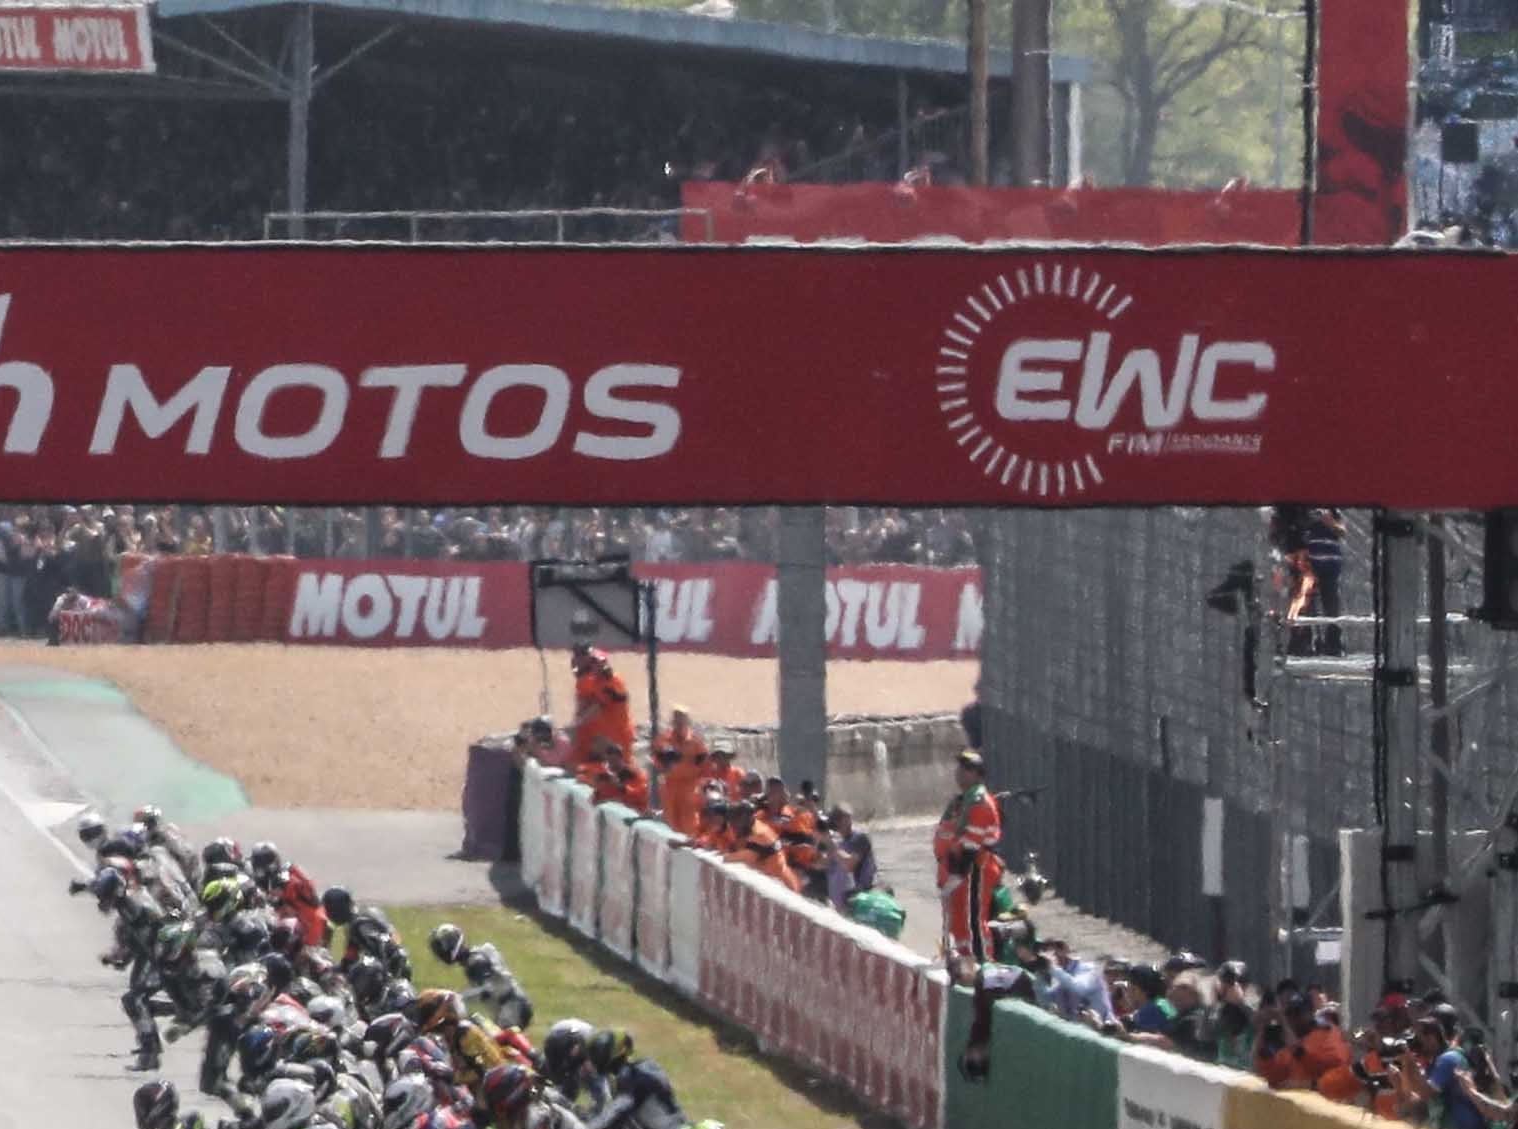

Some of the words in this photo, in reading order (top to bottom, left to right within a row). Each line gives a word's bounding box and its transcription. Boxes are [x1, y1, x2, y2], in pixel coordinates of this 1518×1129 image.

[89, 362, 683, 460] MOTOS
[995, 331, 1277, 431] EWC
[1107, 432, 1164, 454] FIM
[288, 571, 486, 641] MOTUL
